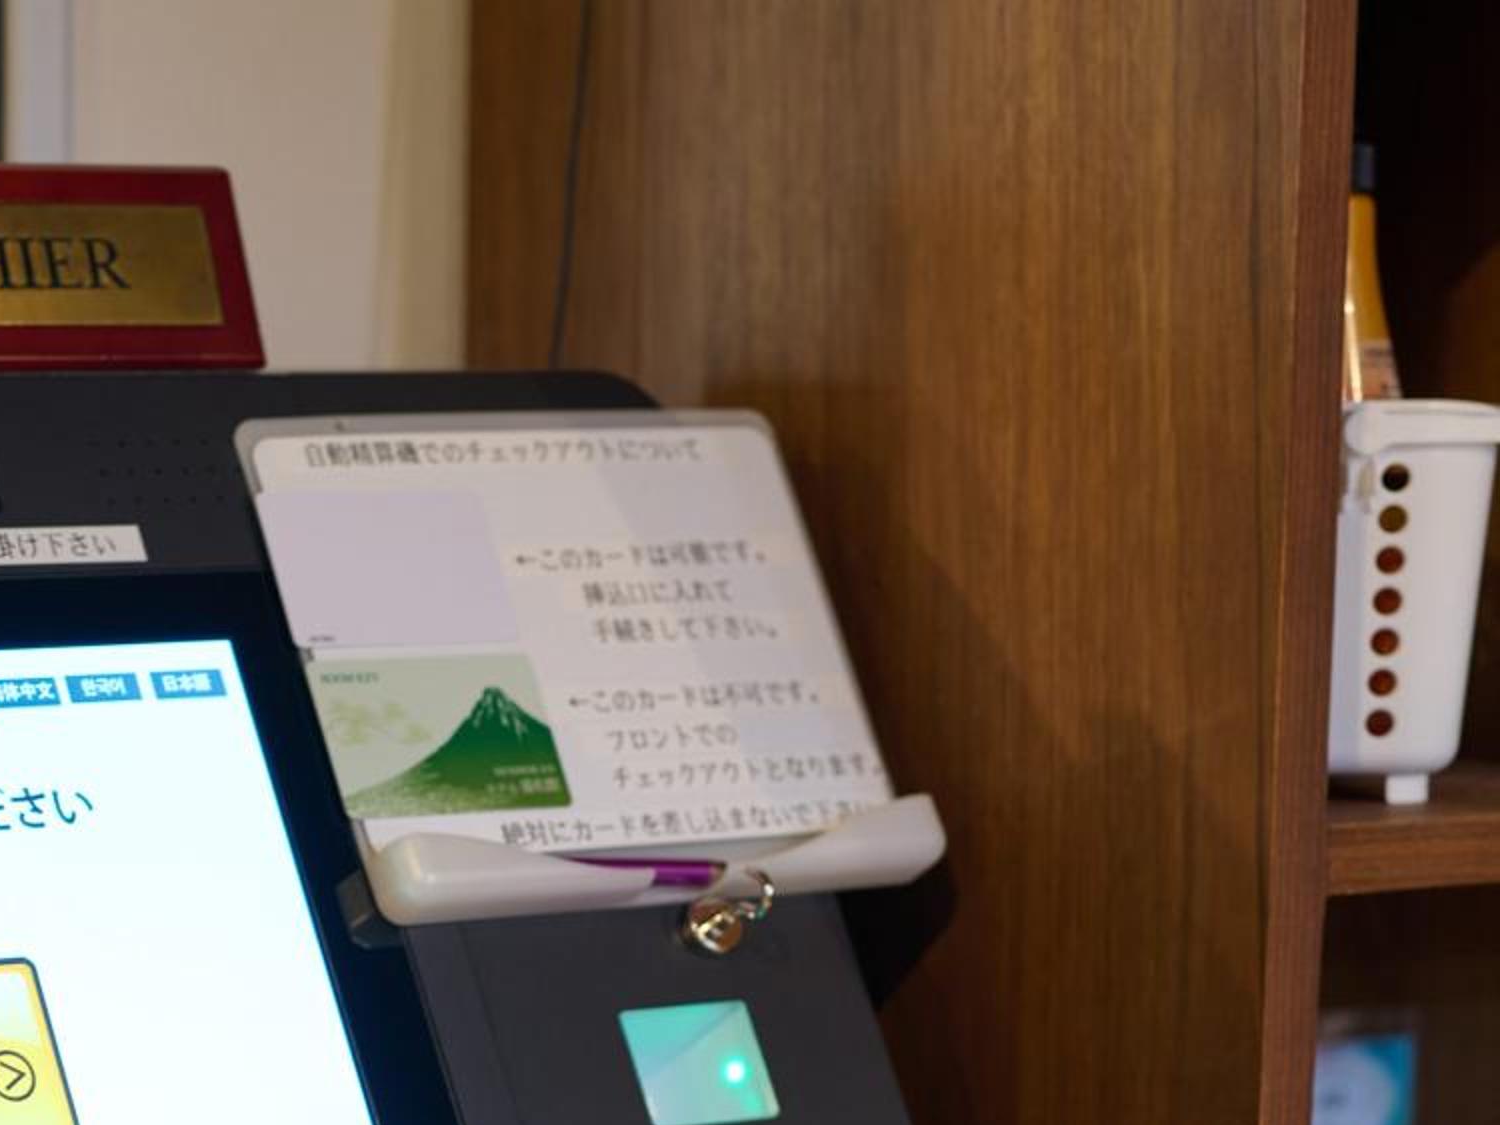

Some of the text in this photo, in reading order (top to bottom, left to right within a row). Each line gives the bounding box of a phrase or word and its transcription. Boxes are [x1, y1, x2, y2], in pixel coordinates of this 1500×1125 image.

[80, 676, 127, 698] 한국어
[161, 672, 212, 693] 日本語
[607, 722, 738, 751] フロントでの
